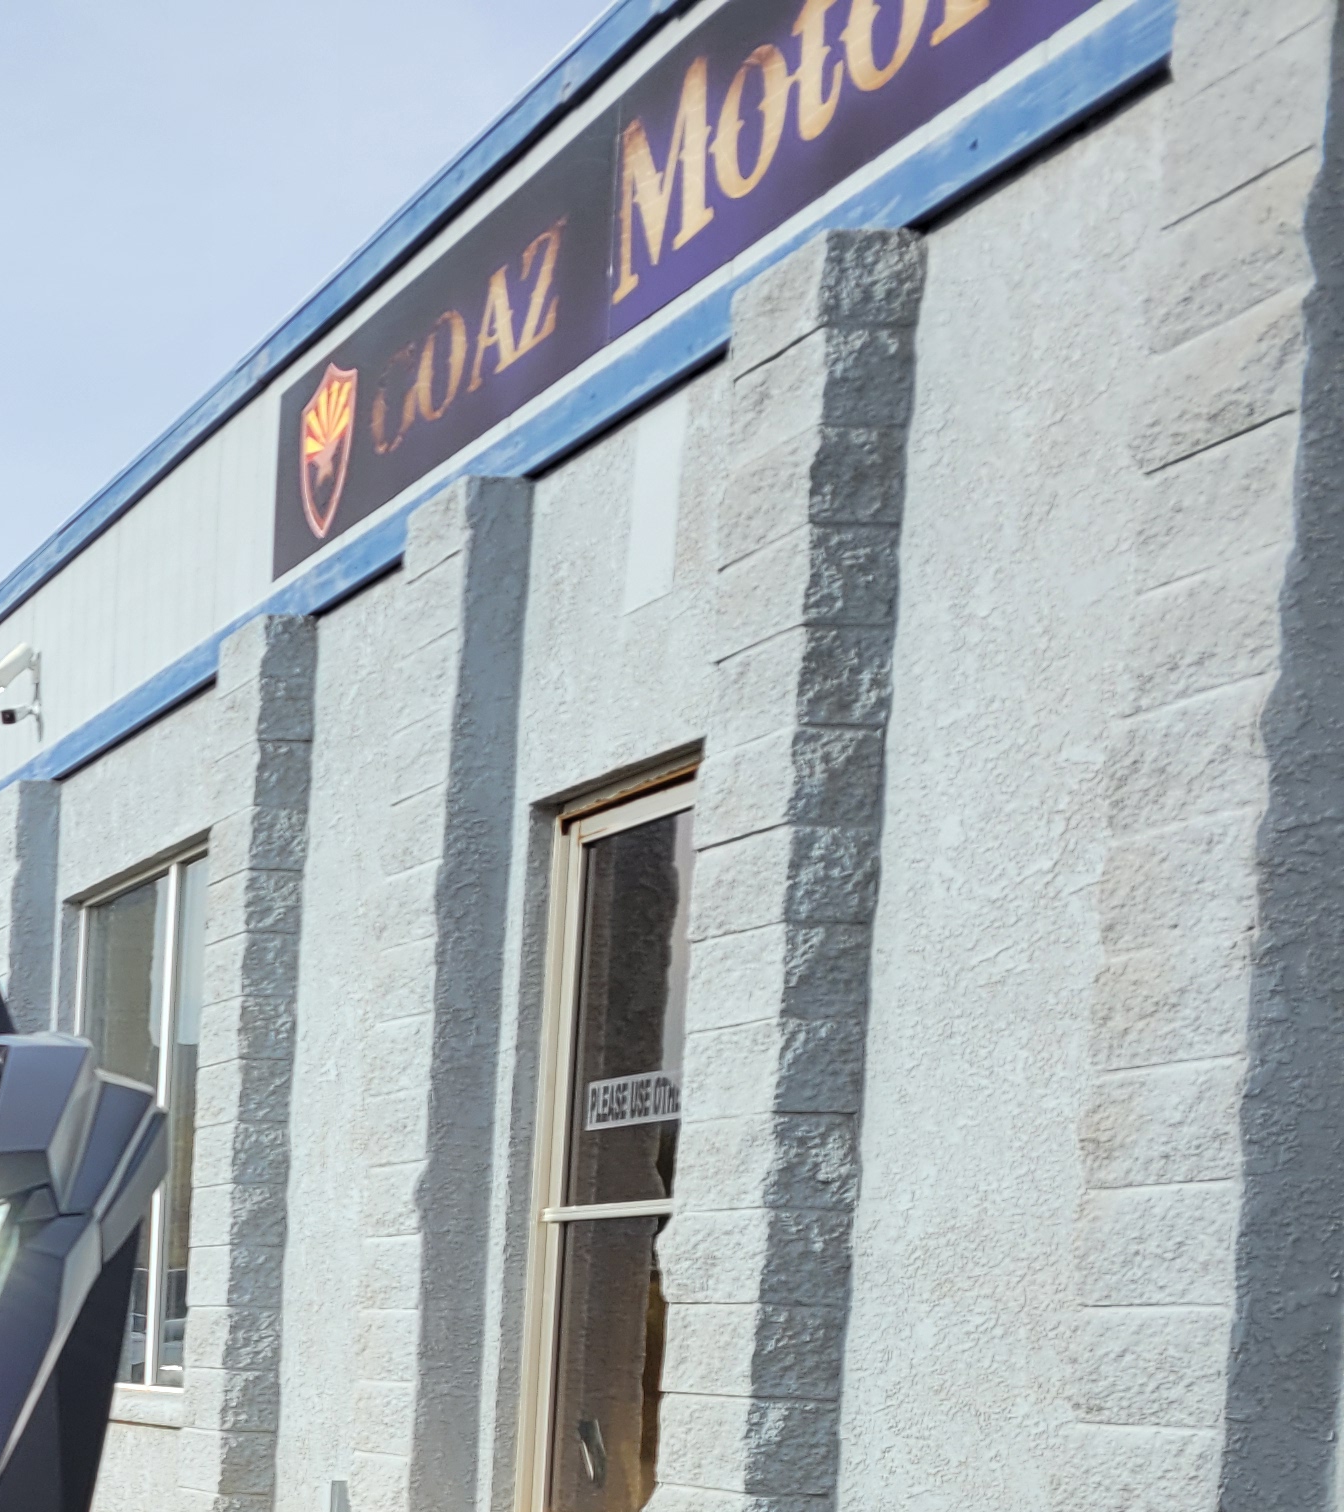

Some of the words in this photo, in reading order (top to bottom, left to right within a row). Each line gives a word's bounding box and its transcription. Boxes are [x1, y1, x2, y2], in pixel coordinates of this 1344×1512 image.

[372, 214, 568, 455] GOAZ
[589, 1082, 629, 1124] PLEASE
[629, 1079, 651, 1118] USE
